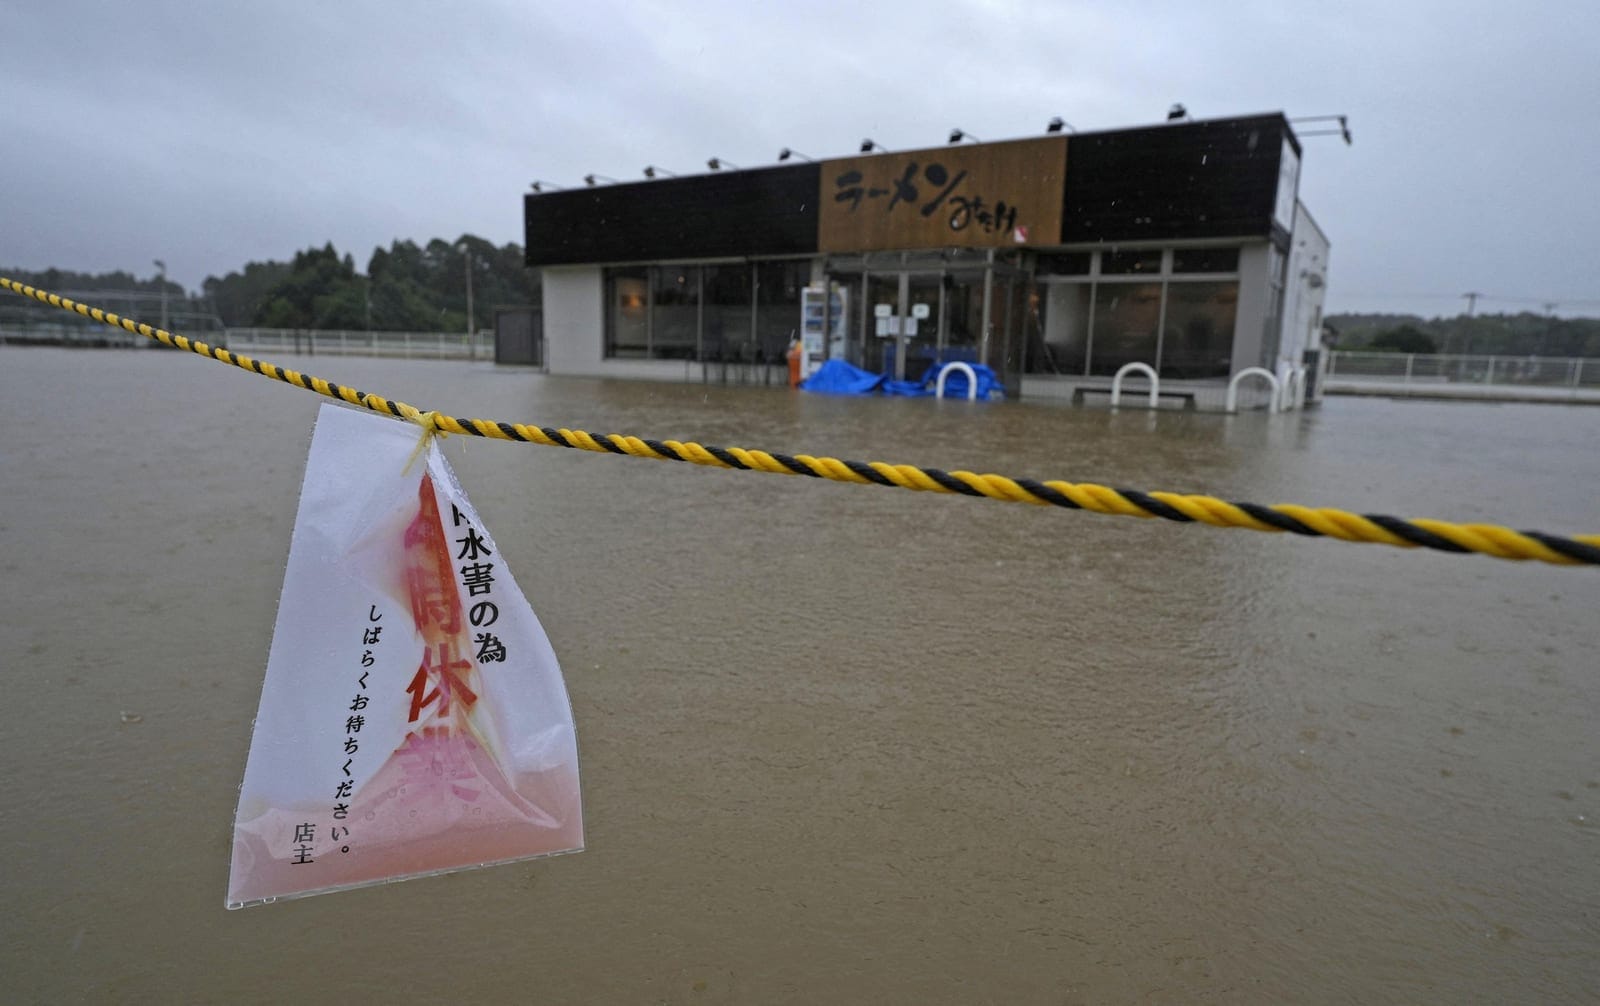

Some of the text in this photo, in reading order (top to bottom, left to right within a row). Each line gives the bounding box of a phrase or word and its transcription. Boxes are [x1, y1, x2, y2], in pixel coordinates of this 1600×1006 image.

[835, 162, 968, 218] ラーメン
[331, 604, 383, 854] しばらくお待ちください。
[291, 823, 317, 865] 店主
